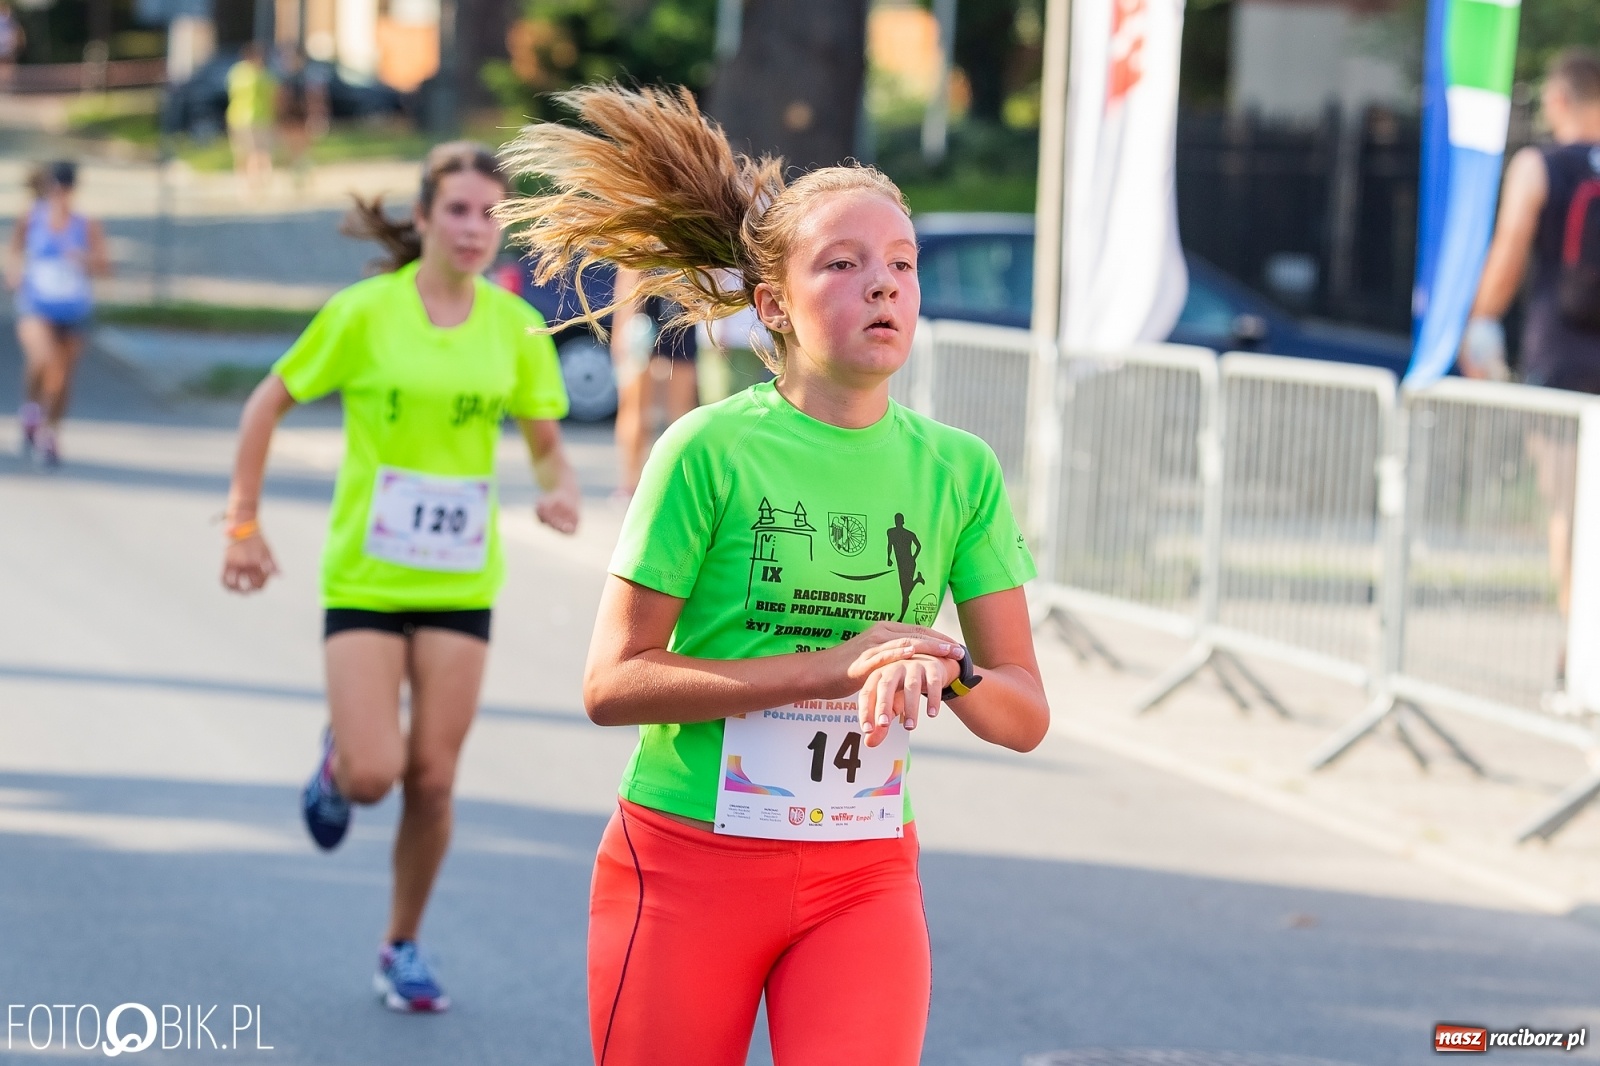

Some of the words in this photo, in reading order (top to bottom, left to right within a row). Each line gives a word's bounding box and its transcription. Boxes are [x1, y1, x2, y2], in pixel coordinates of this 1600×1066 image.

[412, 504, 468, 535] 120
[761, 566, 783, 583] IX
[793, 588, 867, 605] RACIBORSKI
[755, 600, 786, 613] BIEG
[790, 604, 896, 622] PROFILAKTYCZNY
[745, 618, 771, 633] ŻYJ
[774, 624, 833, 639] ZDROWO
[793, 700, 823, 711] MINI
[763, 709, 841, 723] PÓŁMARATON
[807, 730, 862, 784] 14
